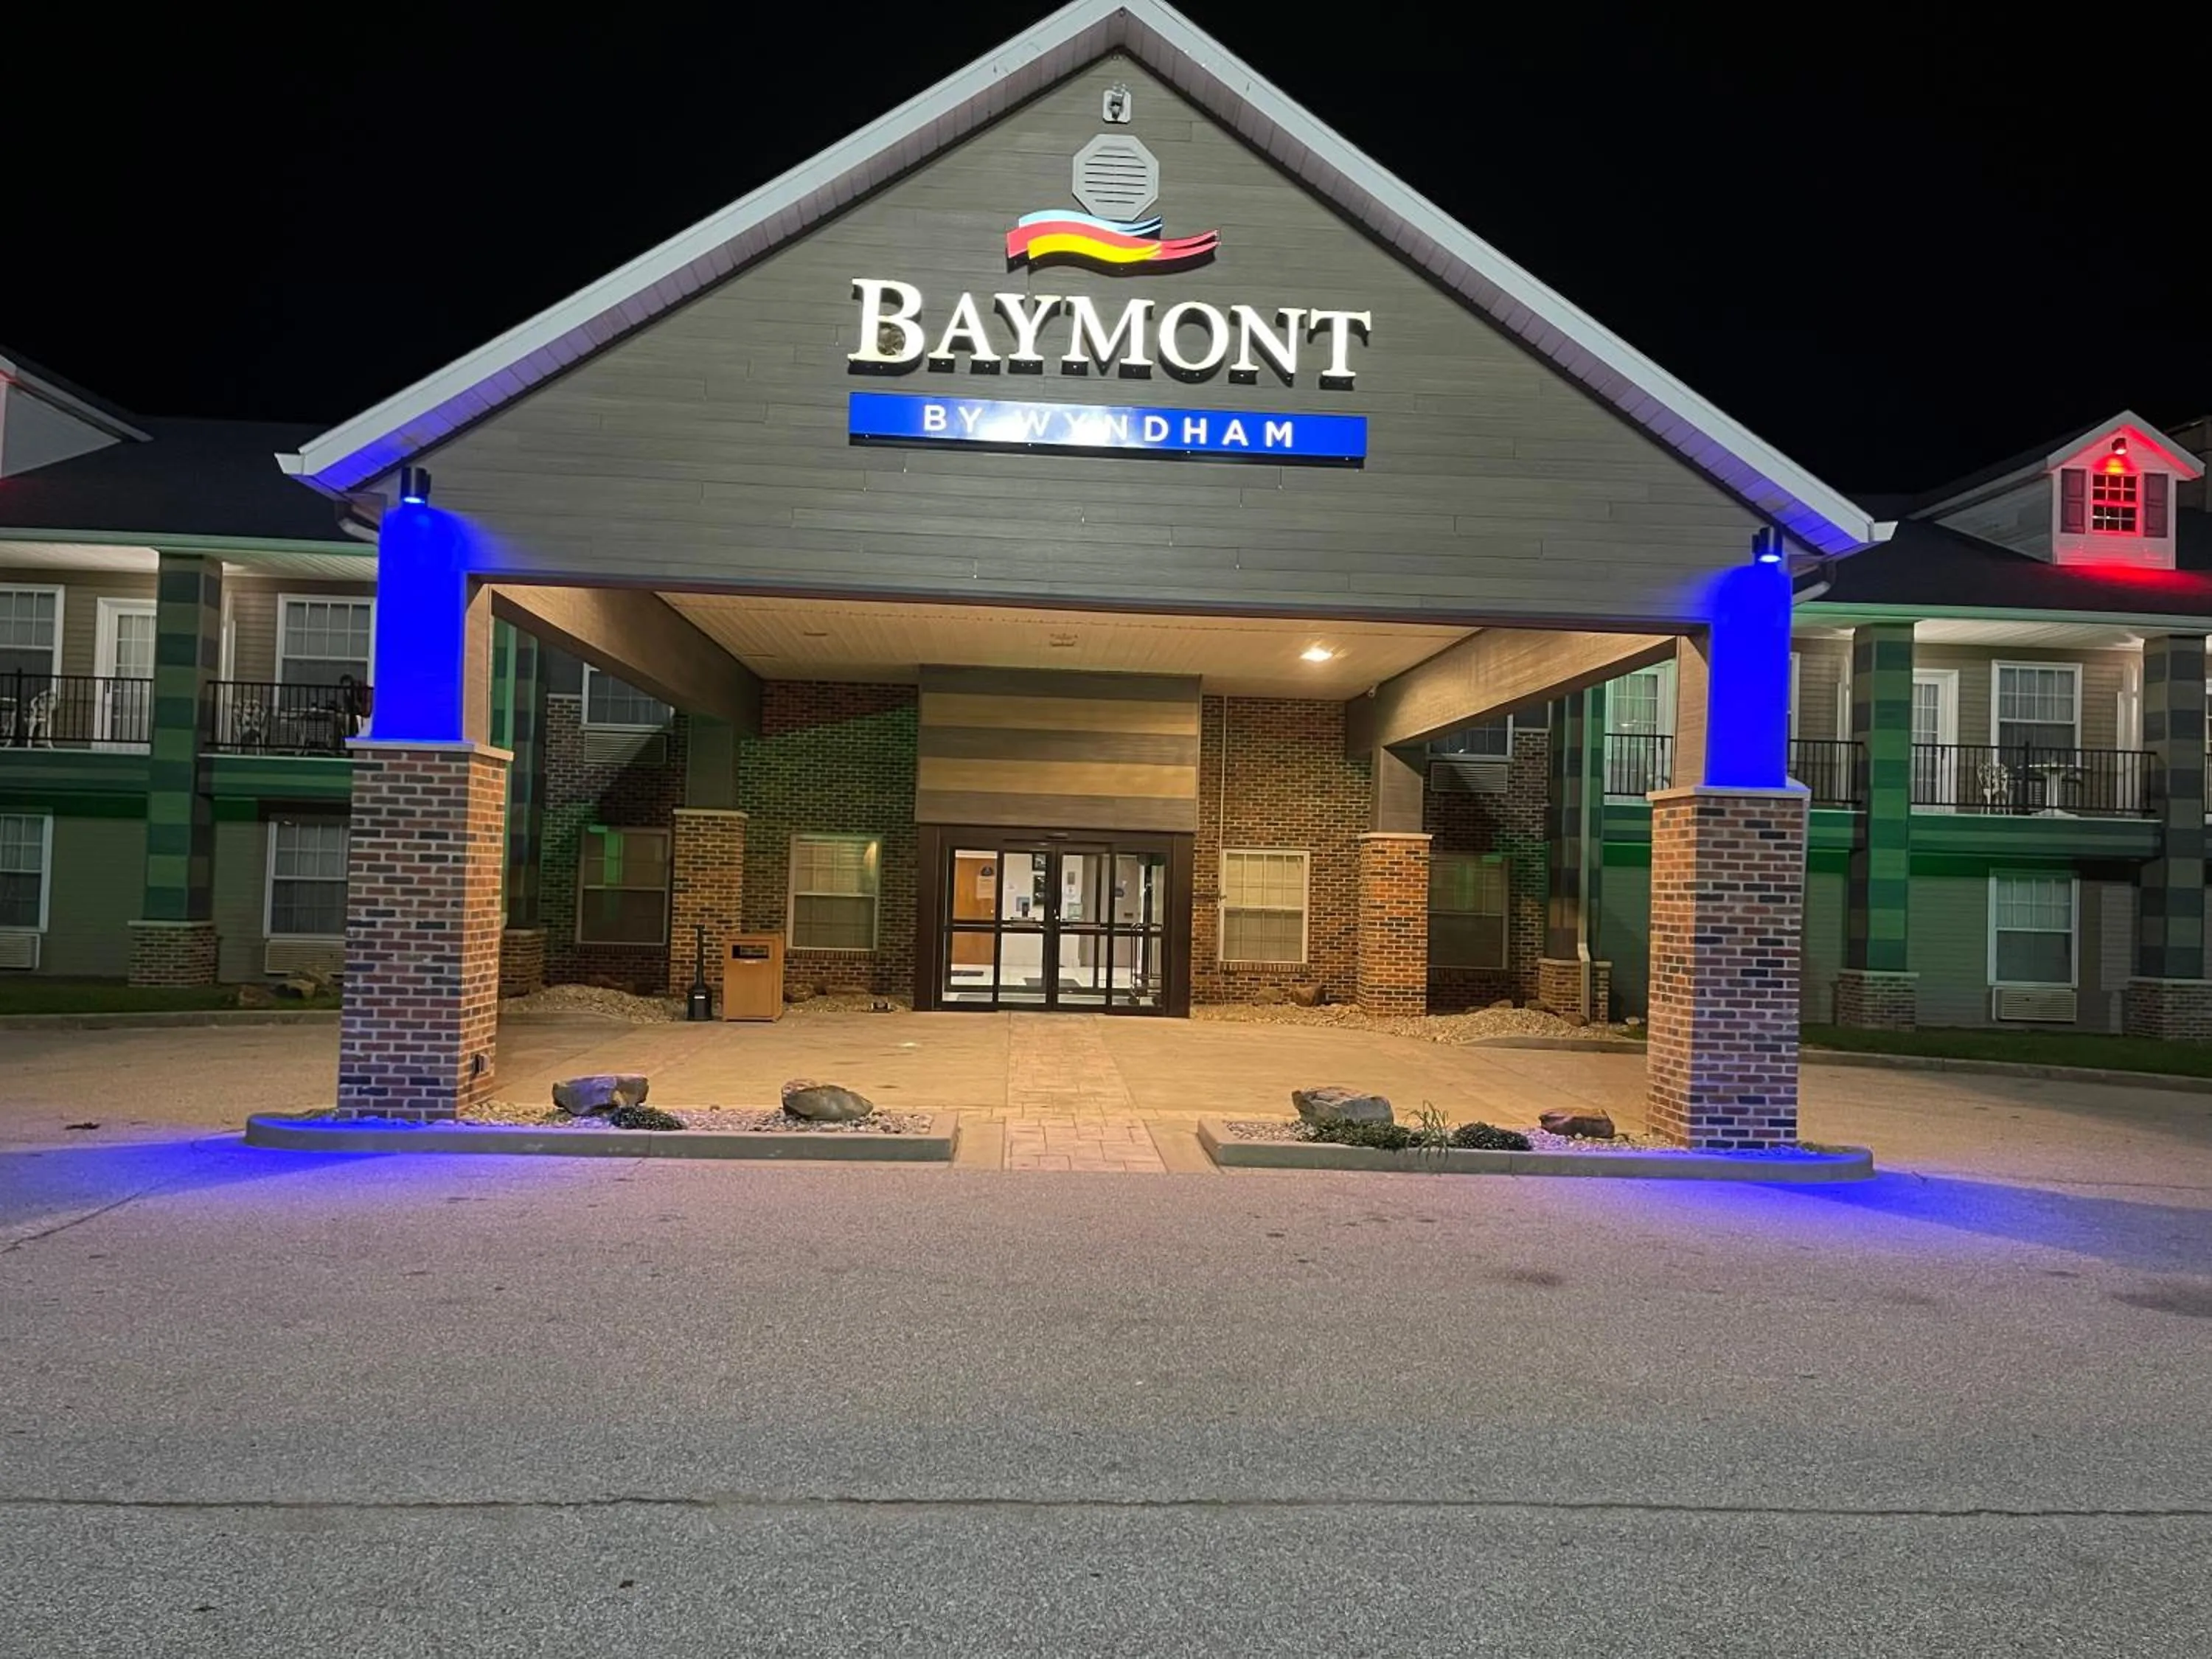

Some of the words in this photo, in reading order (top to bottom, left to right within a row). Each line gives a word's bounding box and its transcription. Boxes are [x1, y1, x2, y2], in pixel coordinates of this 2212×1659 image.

[848, 278, 1371, 378] BAYMONT
[923, 404, 983, 431] BY
[1017, 407, 1293, 448] WYNDHAM
